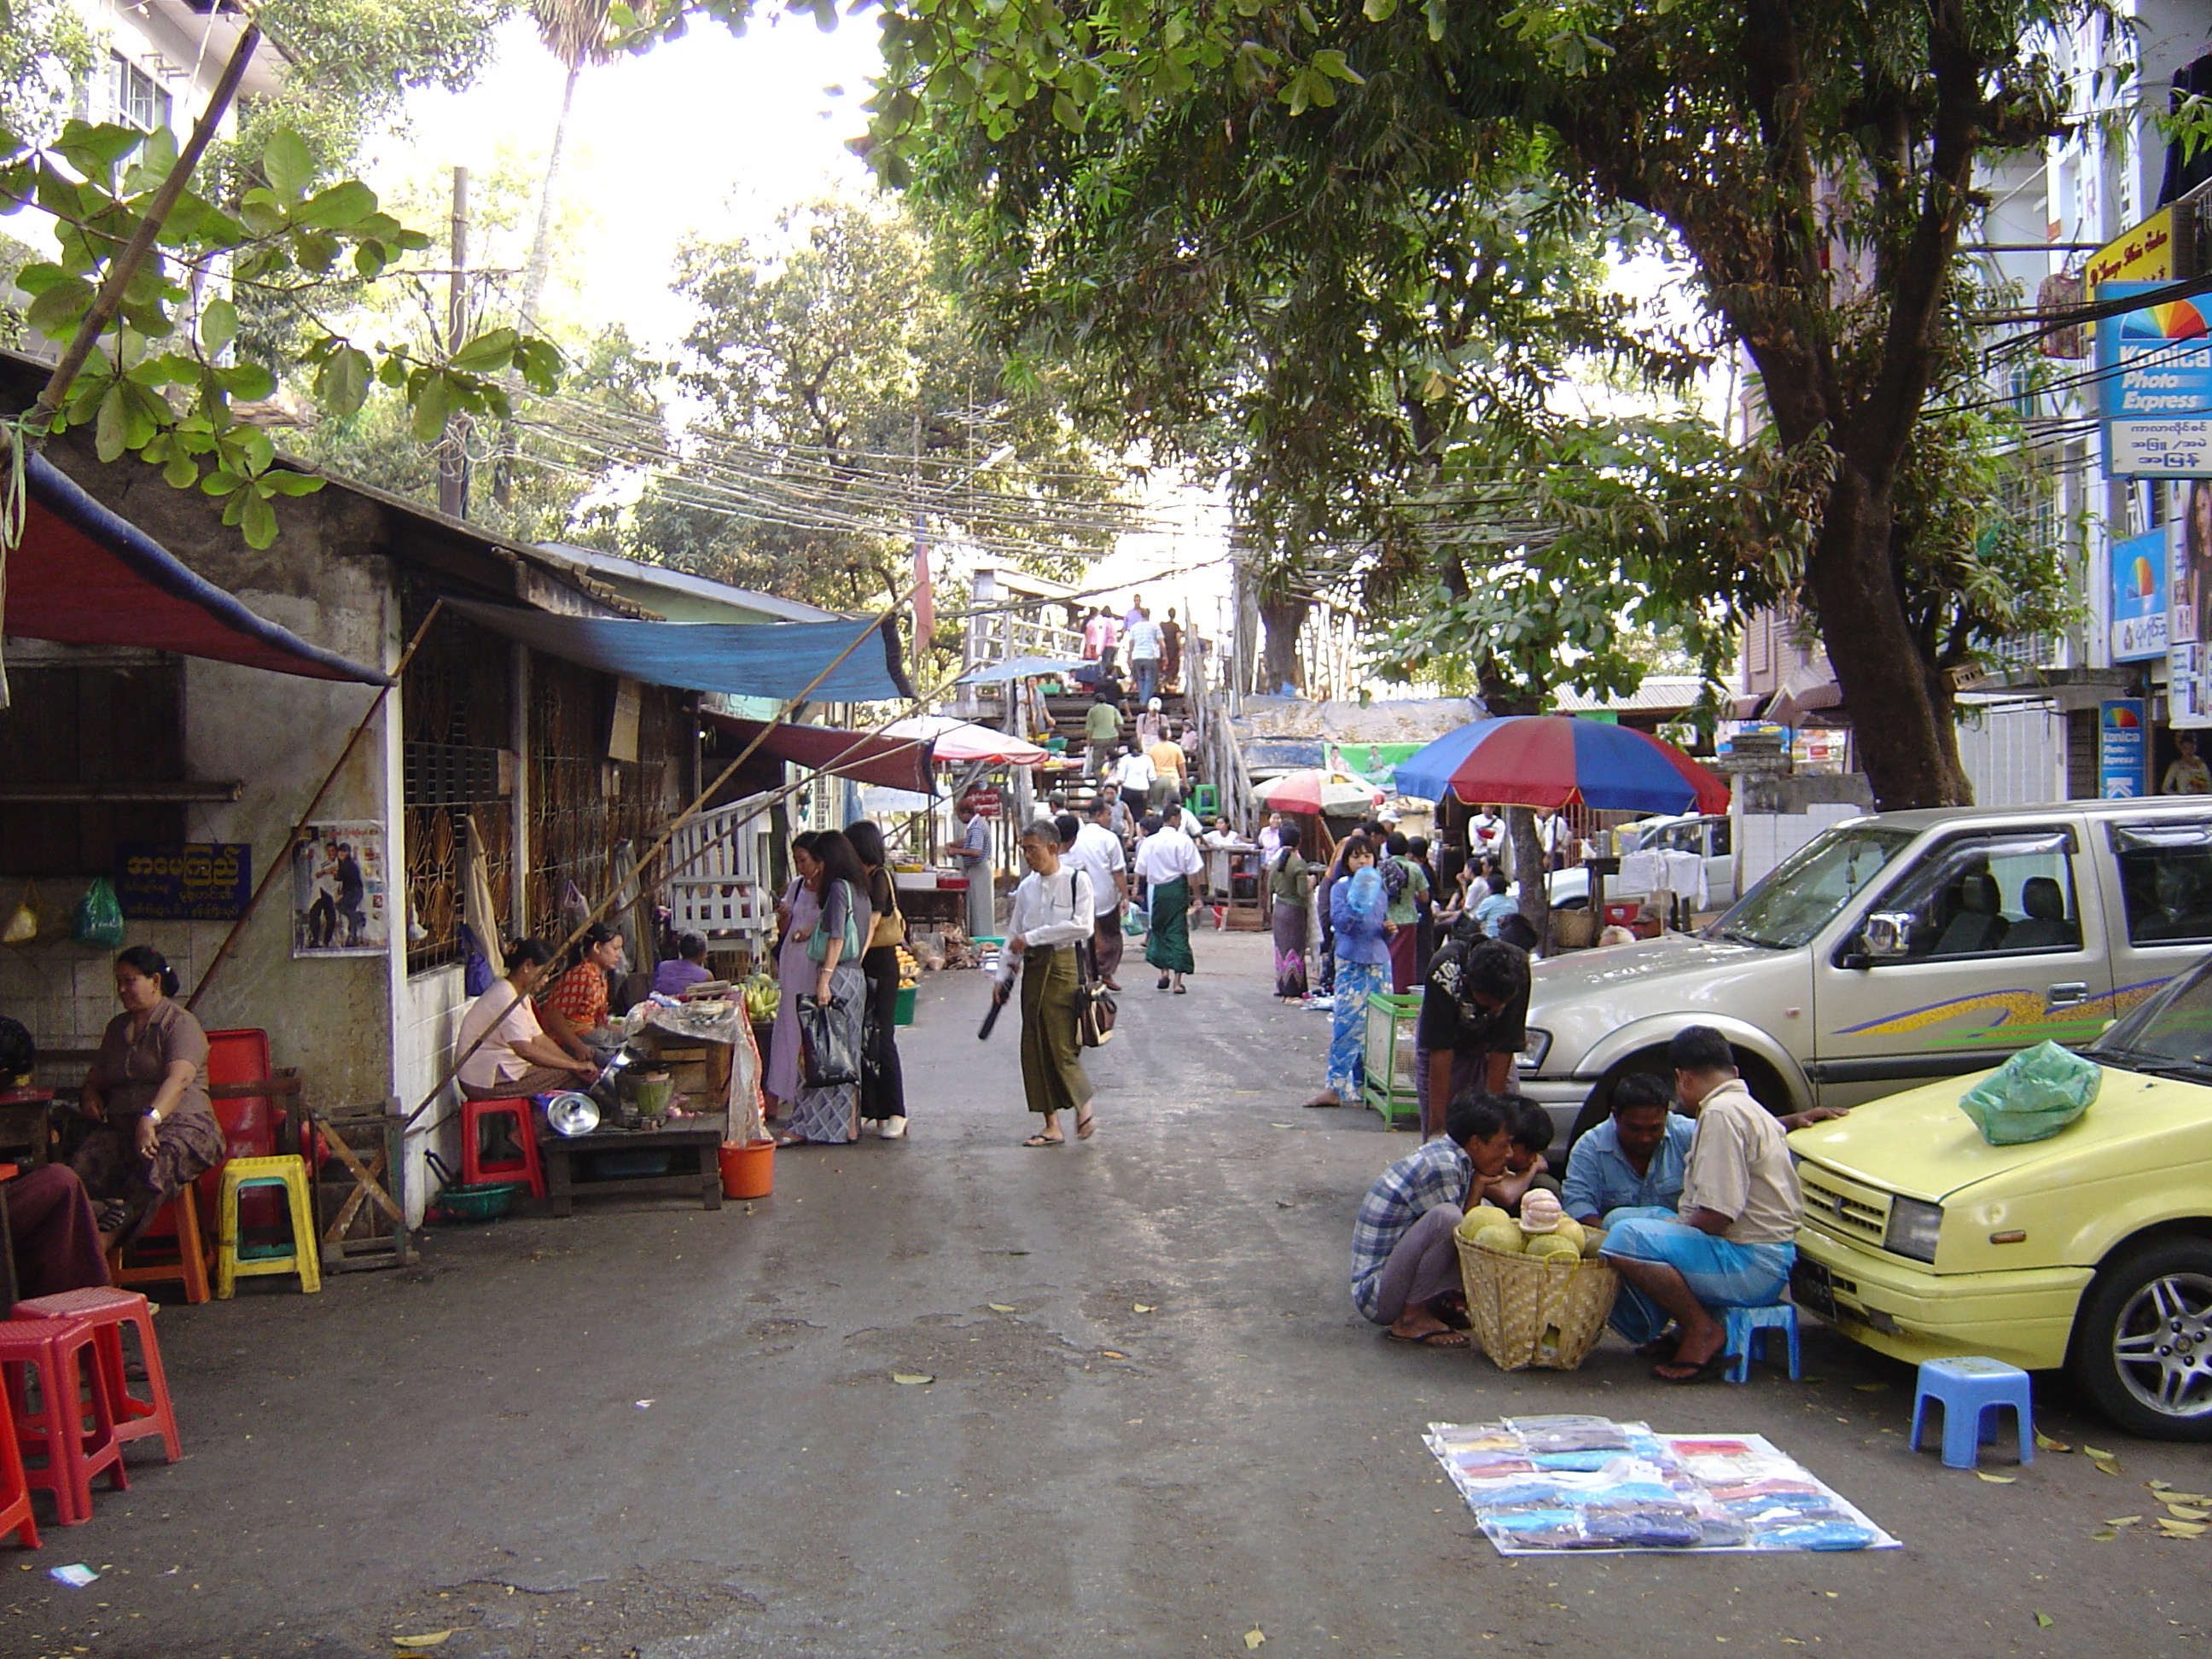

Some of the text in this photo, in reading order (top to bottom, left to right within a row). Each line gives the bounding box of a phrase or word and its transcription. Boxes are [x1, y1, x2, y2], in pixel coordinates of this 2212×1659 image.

[2119, 344, 2211, 368] Konica
[2122, 368, 2179, 388] Photo
[2122, 391, 2198, 411] Express
